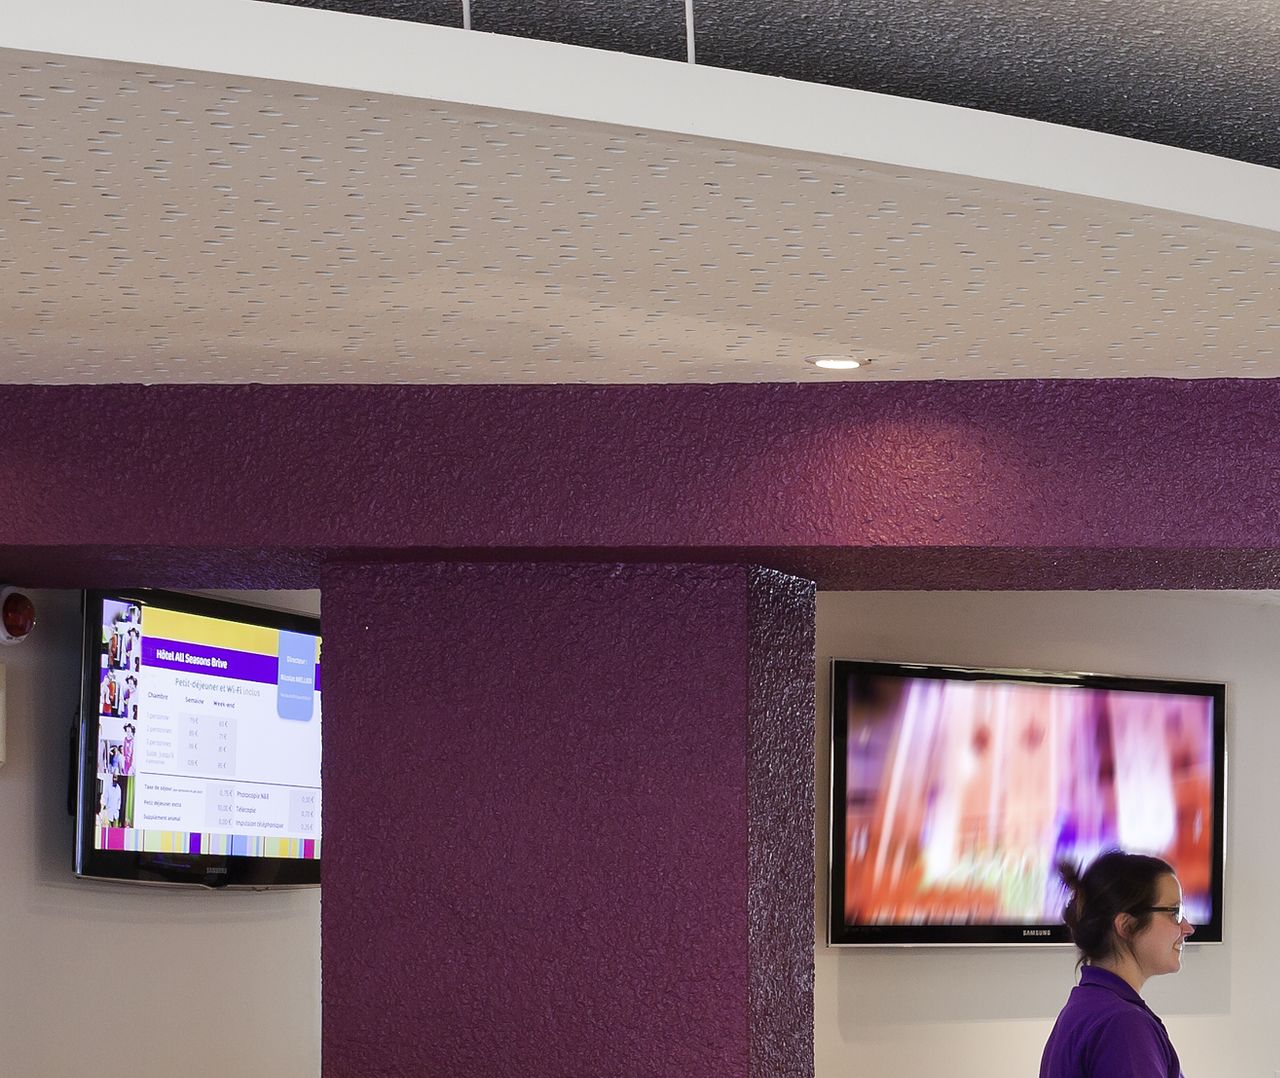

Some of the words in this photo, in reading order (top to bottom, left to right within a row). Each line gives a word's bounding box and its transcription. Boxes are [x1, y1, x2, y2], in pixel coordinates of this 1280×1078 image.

[156, 649, 175, 661] Hôtel
[174, 651, 185, 662] All
[185, 653, 211, 667] Seasons
[211, 656, 228, 669] Brive
[148, 691, 168, 700] Chambre
[175, 677, 219, 691] Petit-déjeuner
[219, 684, 226, 692] et
[226, 685, 242, 695] Wi-Fi
[242, 687, 261, 697] inclus
